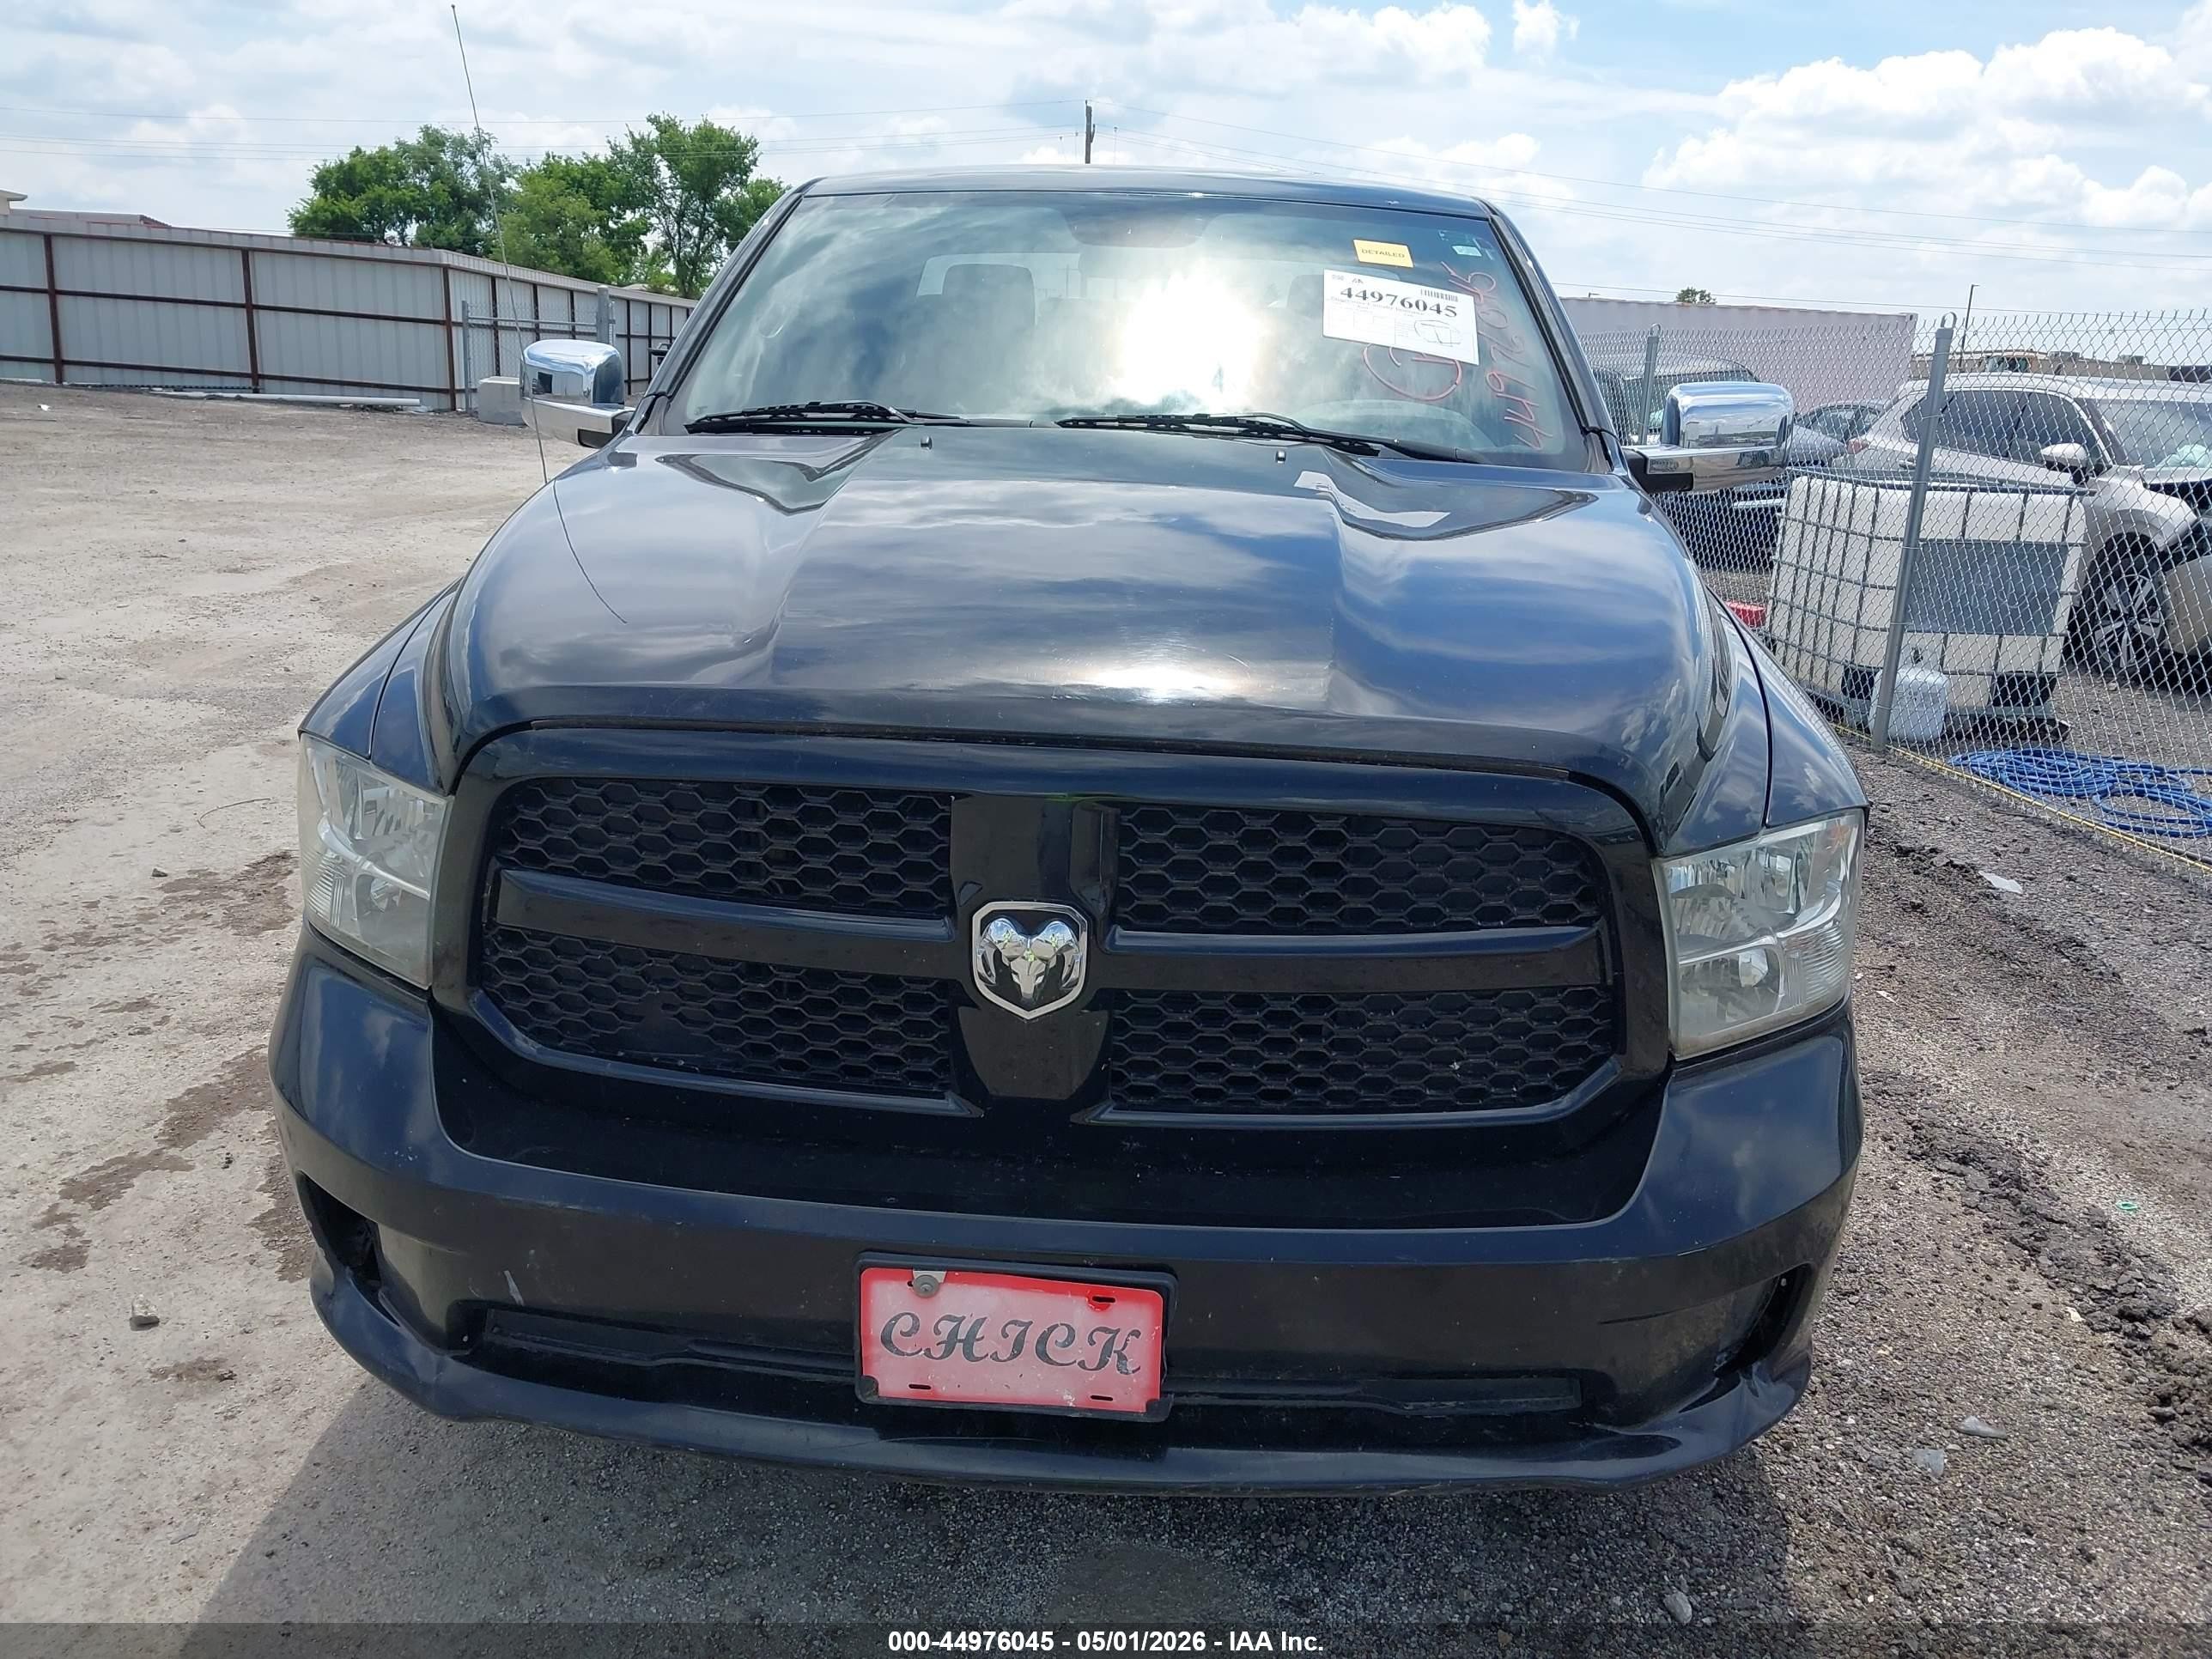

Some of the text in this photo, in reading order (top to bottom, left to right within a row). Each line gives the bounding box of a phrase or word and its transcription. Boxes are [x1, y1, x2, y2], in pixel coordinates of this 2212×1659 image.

[1361, 248, 1406, 258] DETAILED
[1340, 287, 1458, 318] 44976045
[879, 1311, 1142, 1376] CHICK
